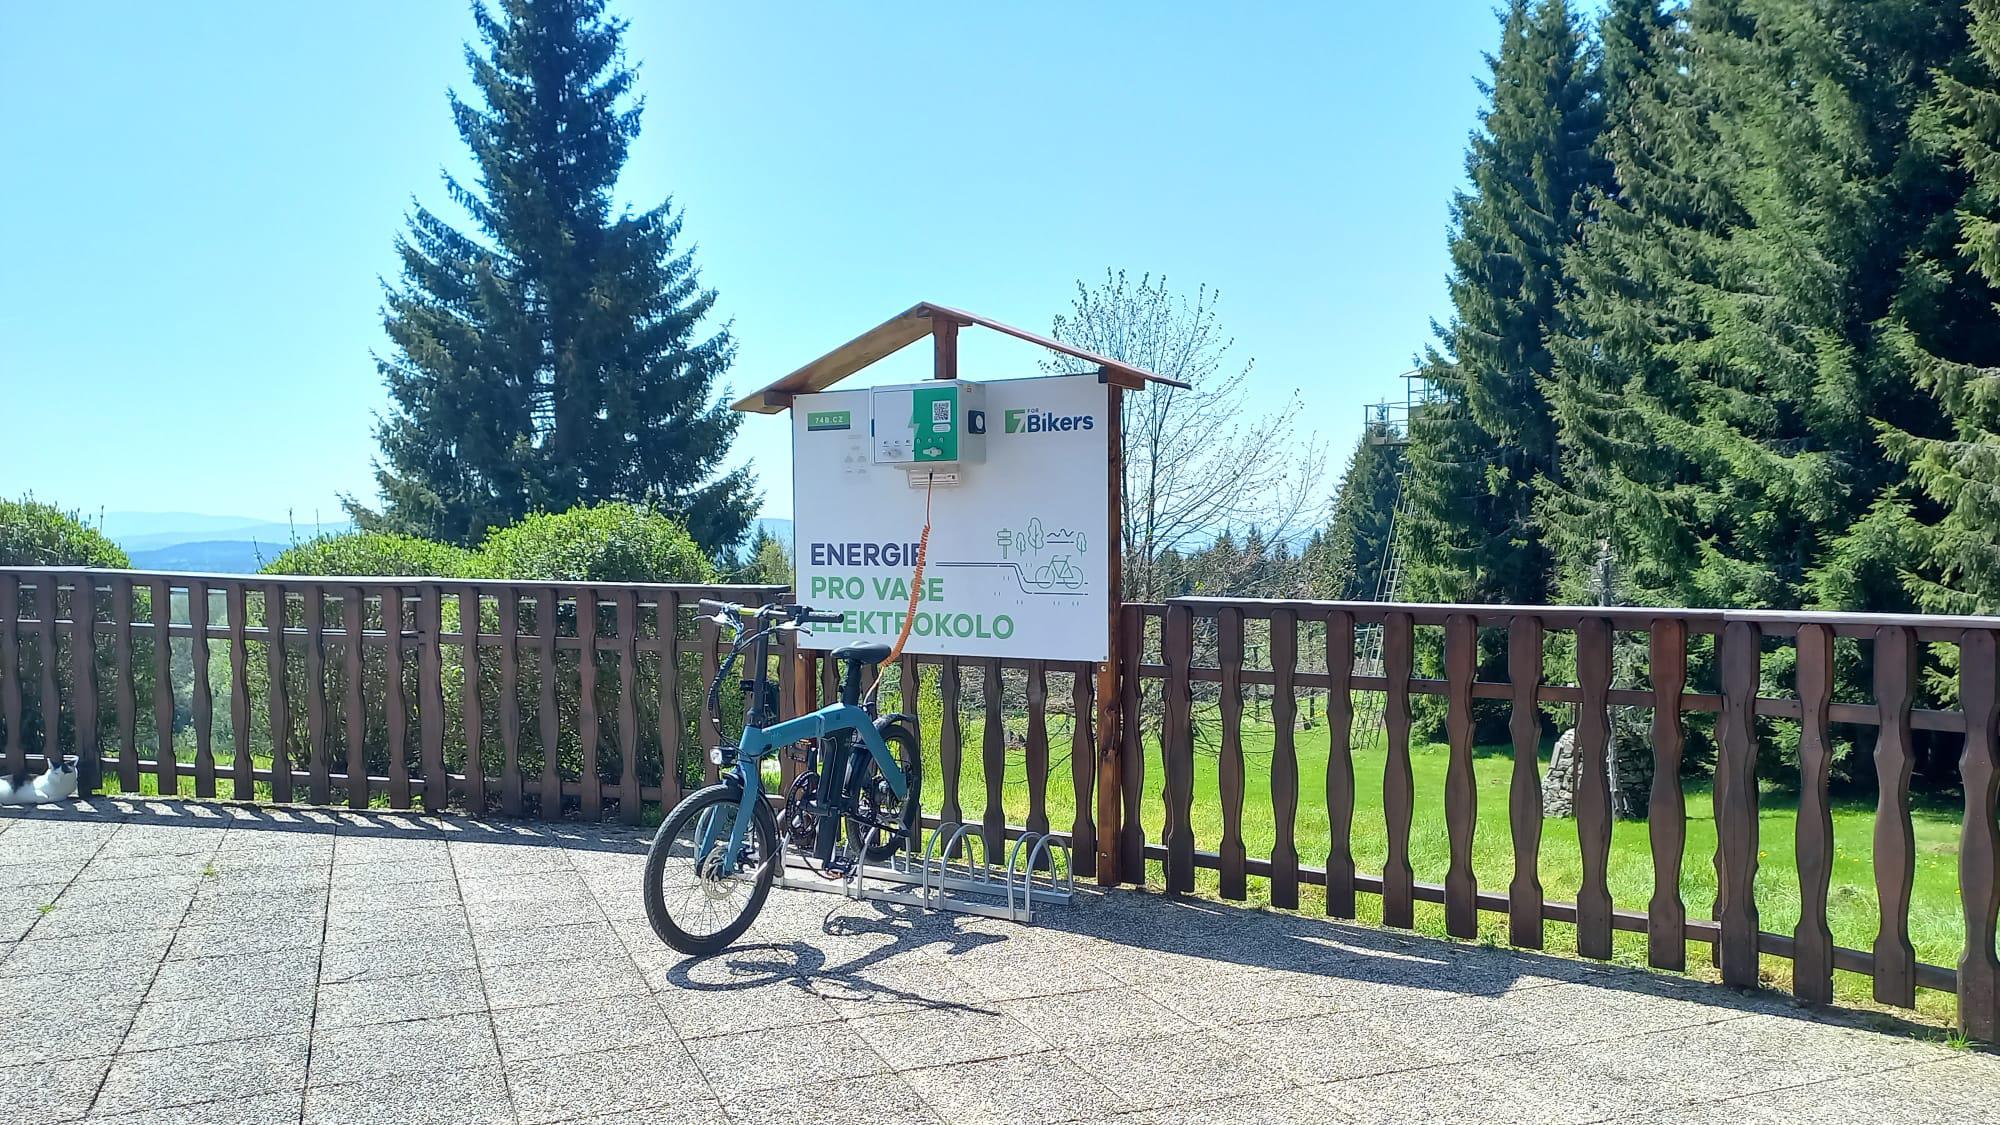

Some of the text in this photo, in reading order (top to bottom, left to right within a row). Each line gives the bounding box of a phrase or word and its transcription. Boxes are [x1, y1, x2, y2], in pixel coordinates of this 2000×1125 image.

[1027, 412, 1094, 433] Bikers
[810, 542, 926, 567] ENERGIE
[811, 576, 865, 600] PRO
